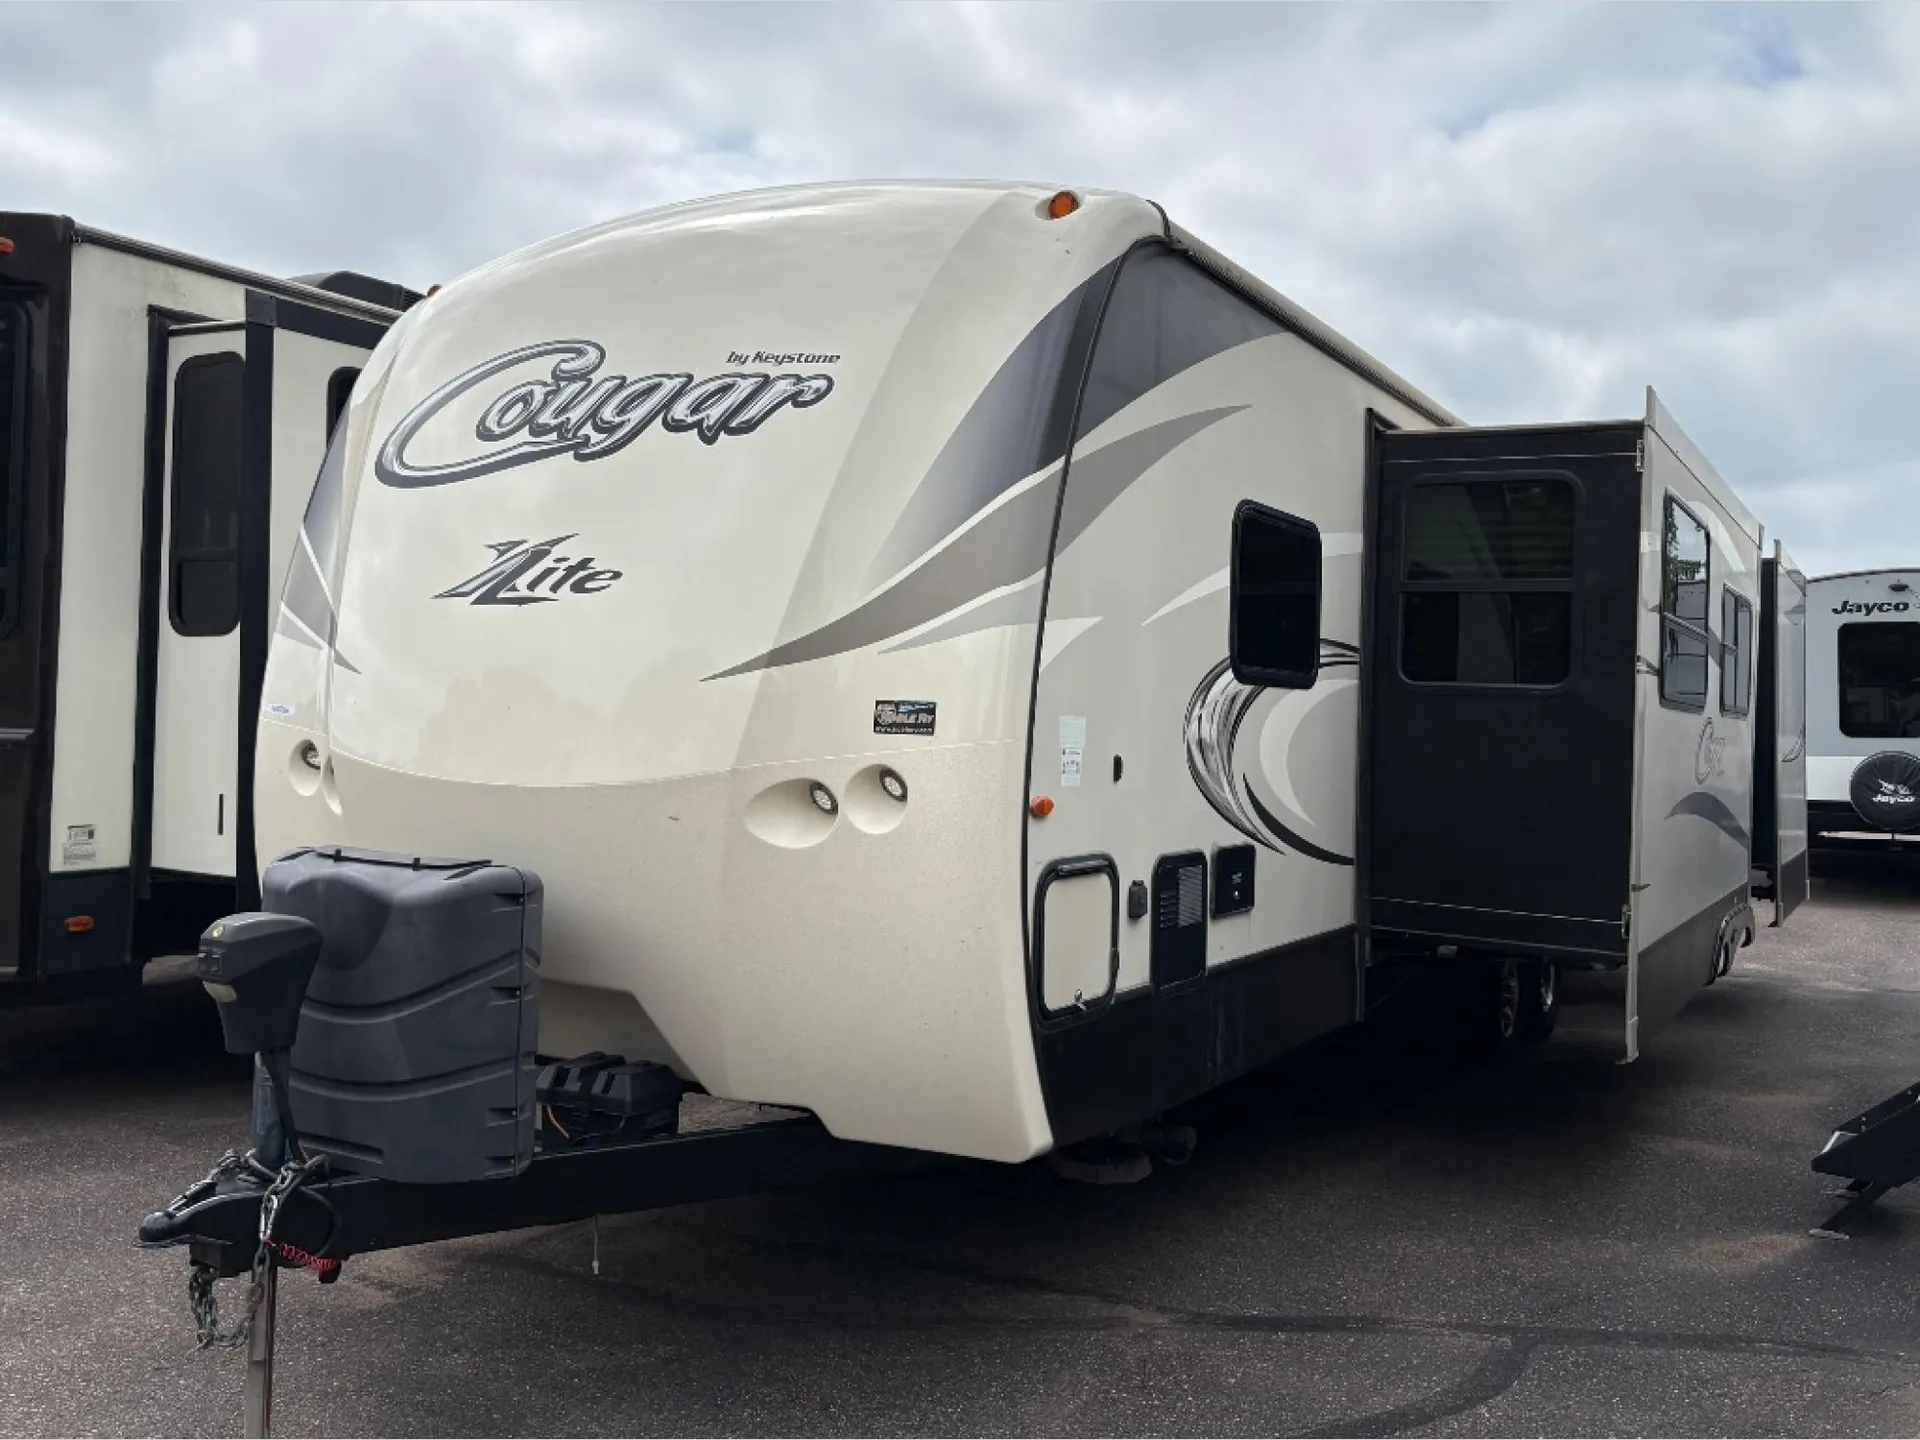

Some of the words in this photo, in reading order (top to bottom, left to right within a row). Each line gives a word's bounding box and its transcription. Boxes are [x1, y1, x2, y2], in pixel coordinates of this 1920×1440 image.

[725, 351, 750, 366] by
[751, 351, 841, 367] Keystone
[374, 338, 835, 489] Cougar
[1831, 600, 1909, 616] Jayco
[1872, 793, 1916, 804] Jayco
